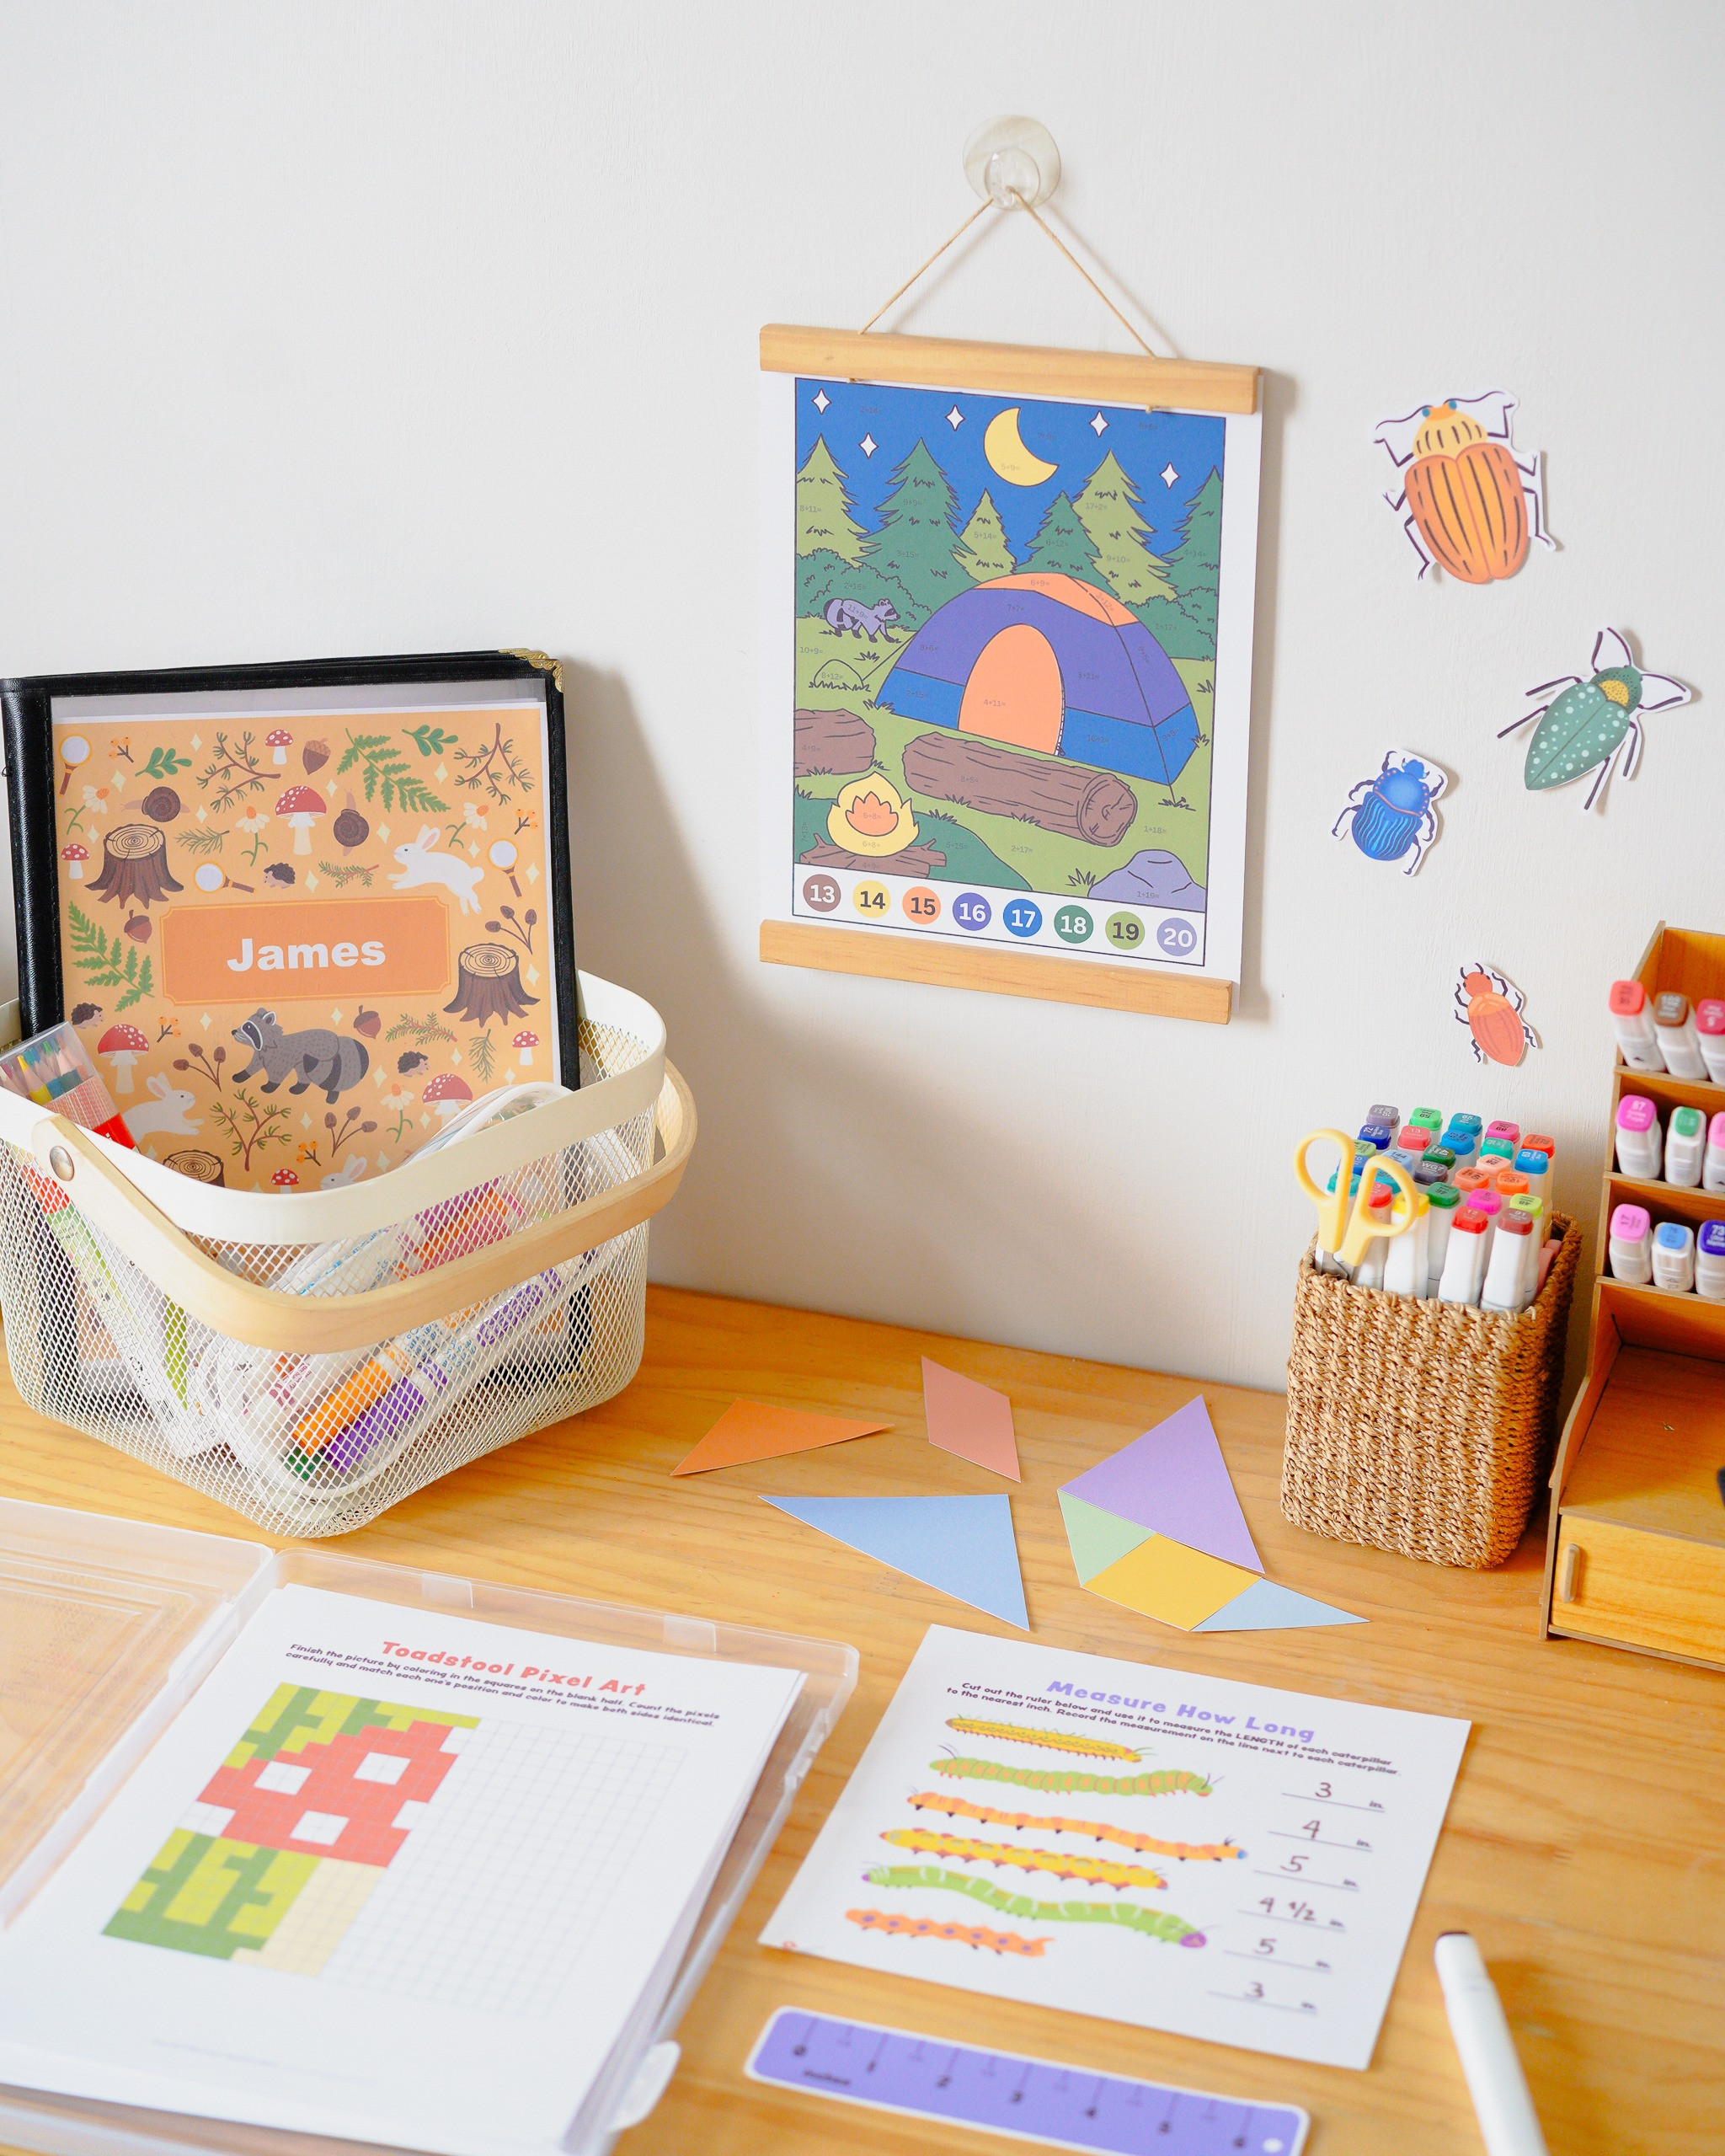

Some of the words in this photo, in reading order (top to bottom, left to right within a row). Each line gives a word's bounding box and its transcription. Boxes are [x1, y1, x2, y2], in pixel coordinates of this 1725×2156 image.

[799, 505, 822, 513] 8+11=
[1085, 503, 1108, 511] 17+2=
[974, 532, 997, 540] 5+14=
[896, 549, 919, 559] 3+15=
[1106, 554, 1130, 564] 9+10=
[847, 603, 869, 620] 11+9=
[799, 646, 824, 655] 10+9=
[983, 698, 1007, 708] 4+11=
[1144, 826, 1167, 834] 1+18=
[1011, 845, 1033, 853] 2+17=
[1137, 891, 1160, 900] 1+19=
[809, 884, 836, 904] 13
[860, 891, 886, 910] 14
[911, 896, 936, 916] 15
[959, 902, 986, 923] 16
[1011, 908, 1036, 928] 17
[1060, 915, 1087, 934] 18
[1112, 922, 1140, 941] 19
[1162, 927, 1194, 948] 20
[227, 938, 387, 972] James
[382, 1641, 515, 1675] Toadstool
[521, 1666, 593, 1688] Pixel
[598, 1678, 647, 1696] Art
[285, 1651, 334, 1666] carefully
[336, 1661, 357, 1670] and
[359, 1664, 393, 1677] match
[396, 1672, 421, 1682] each
[425, 1677, 451, 1687] one's
[453, 1682, 499, 1695] position
[502, 1690, 524, 1699] and
[526, 1693, 553, 1704] color
[569, 1702, 600, 1710] make
[602, 1705, 628, 1715] both
[630, 1709, 660, 1719] sides
[290, 1644, 323, 1655] Finish
[326, 1650, 343, 1659] the
[344, 1654, 384, 1666] picture
[387, 1661, 400, 1671] by
[403, 1664, 447, 1679] coloring
[450, 1672, 462, 1680] in
[463, 1675, 481, 1684] the
[483, 1680, 527, 1691] squares
[546, 1688, 564, 1698] the
[567, 1693, 597, 1702] blank
[629, 1701, 663, 1712] Count
[665, 1707, 683, 1715] the
[685, 1710, 721, 1720] pixels
[1046, 1680, 1167, 1713] Measure
[1176, 1704, 1236, 1725] How
[1245, 1716, 1316, 1744] Long
[947, 1687, 959, 1695] to
[961, 1690, 979, 1699] the
[981, 1694, 1024, 1707] nearest
[1026, 1702, 1053, 1713] inch.
[1056, 1709, 1097, 1720] Record
[1098, 1715, 1118, 1725] the
[1120, 1720, 1197, 1739] measurement
[1216, 1737, 1236, 1747] the
[1238, 1741, 1259, 1751] line
[1262, 1746, 1290, 1757] next
[1292, 1751, 1305, 1759] to
[1307, 1754, 1334, 1764] each
[962, 1682, 982, 1692] Cut
[984, 1687, 1003, 1695] out
[1006, 1690, 1023, 1699] the
[1026, 1694, 1053, 1705] ruler
[1055, 1700, 1088, 1711] below
[1090, 1706, 1112, 1715] and
[1163, 1720, 1211, 1734] measure
[1215, 1728, 1233, 1738] the
[1235, 1732, 1284, 1748] LENGTH
[1301, 1744, 1329, 1756] each
[1332, 1751, 1393, 1767] caterpillar
[1315, 1782, 1332, 1798] 3
[1302, 1820, 1321, 1838] 4
[1280, 1855, 1310, 1872] 5
[1253, 1938, 1277, 1955] 5
[1245, 1982, 1265, 1999] 3
